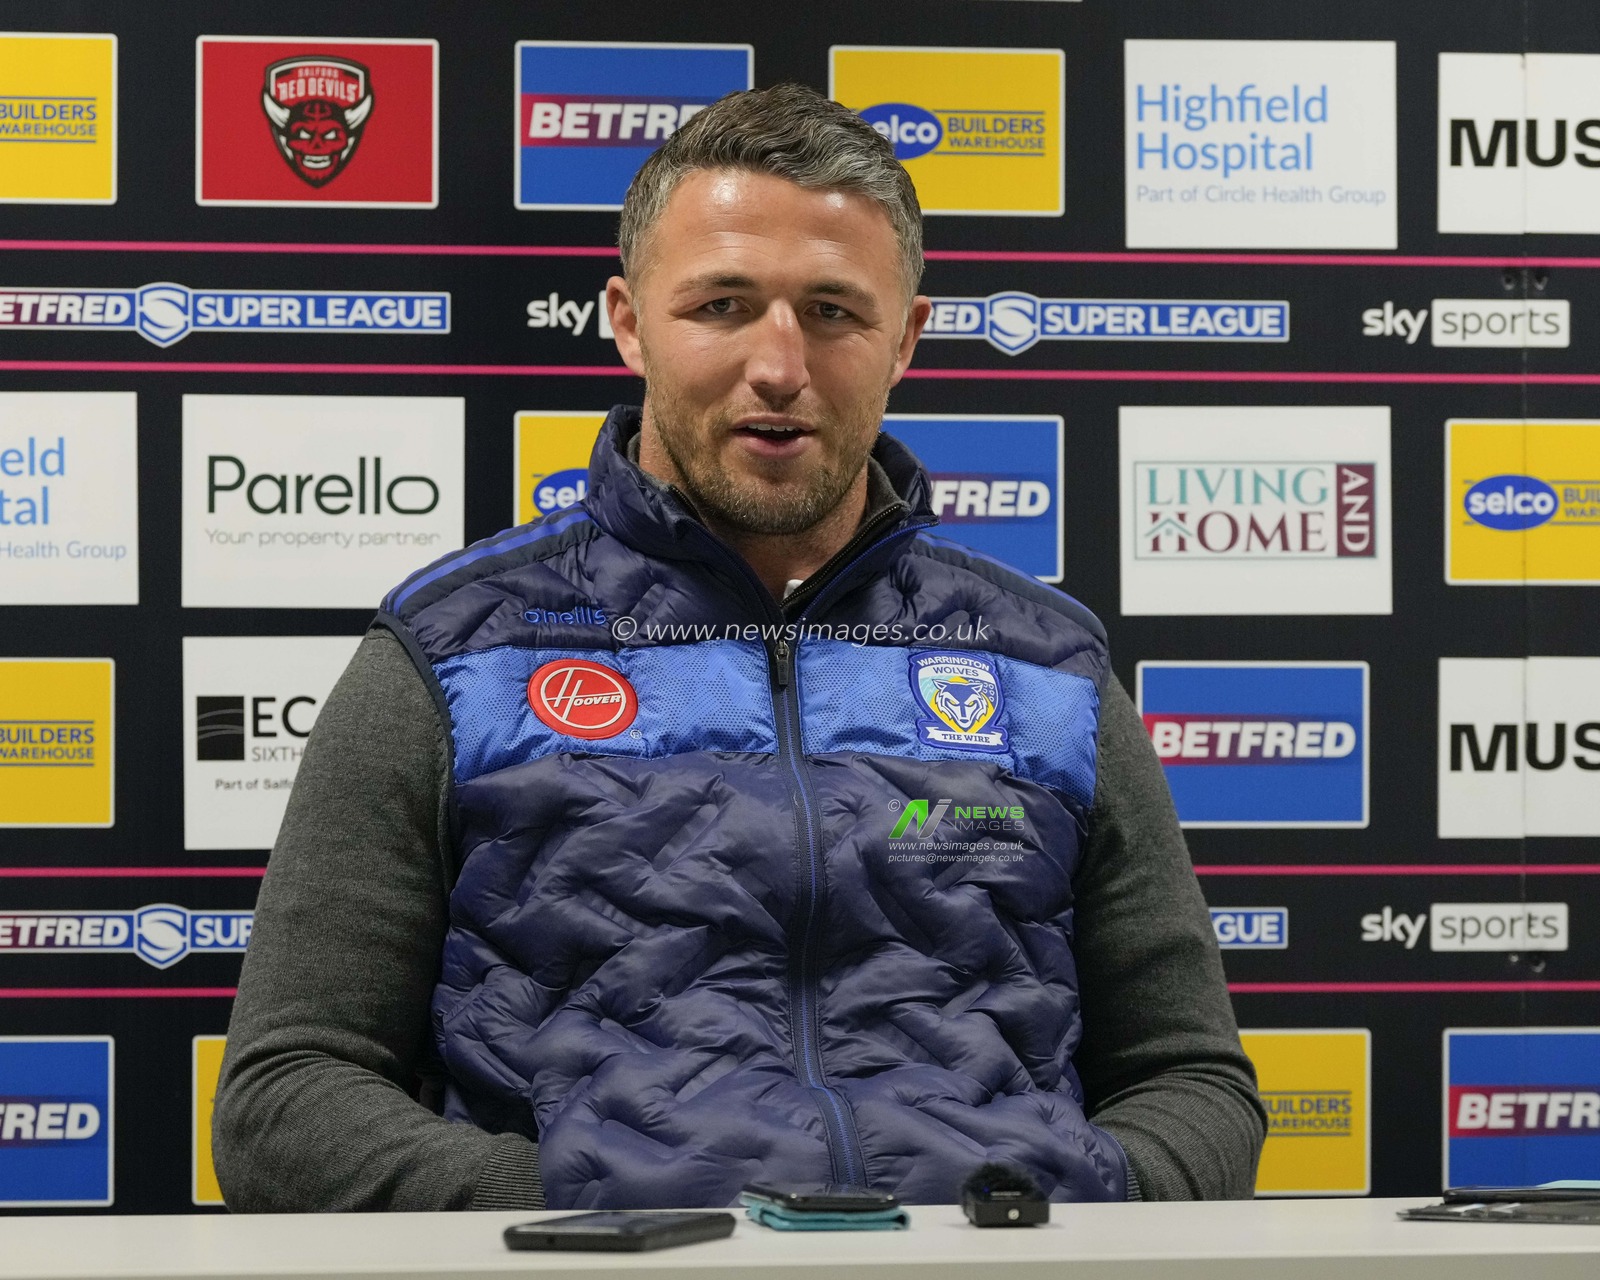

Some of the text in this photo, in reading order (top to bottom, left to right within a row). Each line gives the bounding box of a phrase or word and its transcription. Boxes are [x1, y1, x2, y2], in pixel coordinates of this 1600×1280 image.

[277, 77, 359, 103] RED DEVILS
[0, 104, 97, 120] BUILDERS
[1136, 84, 1328, 131] Highfield
[871, 114, 939, 144] elco
[948, 117, 1046, 134] BUILDERS
[949, 137, 1045, 150] WAREHOUSE
[1136, 133, 1313, 178] Hospital
[1450, 119, 1600, 168] MUS
[1137, 186, 1386, 206] Part of Circle Health Group
[197, 297, 300, 325] SUPER
[307, 299, 442, 327] LEAGUE
[526, 292, 595, 336] sky
[1044, 305, 1147, 333] SUPER
[1150, 306, 1282, 336] LEAGUE
[1362, 301, 1560, 344] sky sports
[0, 436, 65, 476] eld
[208, 455, 439, 515] Parello
[931, 480, 1050, 517] FRED
[1147, 468, 1328, 505] LIVING
[1468, 485, 1555, 515] selco
[1341, 468, 1370, 552] AND
[205, 529, 441, 548] Your property partner
[1150, 511, 1328, 552] HOME
[66, 540, 127, 561] Group
[917, 656, 989, 671] WARRINGTON
[933, 667, 979, 677] WOLVES
[941, 733, 990, 743] THE WIRE
[1152, 722, 1356, 758] BETFRED
[1450, 722, 1600, 771] MUS
[251, 746, 304, 762] SIXTH
[215, 778, 243, 790] Part
[245, 778, 259, 790] of
[1361, 906, 1559, 948] sky sports
[0, 1103, 100, 1140] RED
[1269, 1117, 1350, 1129] AREHOUSE
[1456, 1092, 1600, 1130] BETFR
